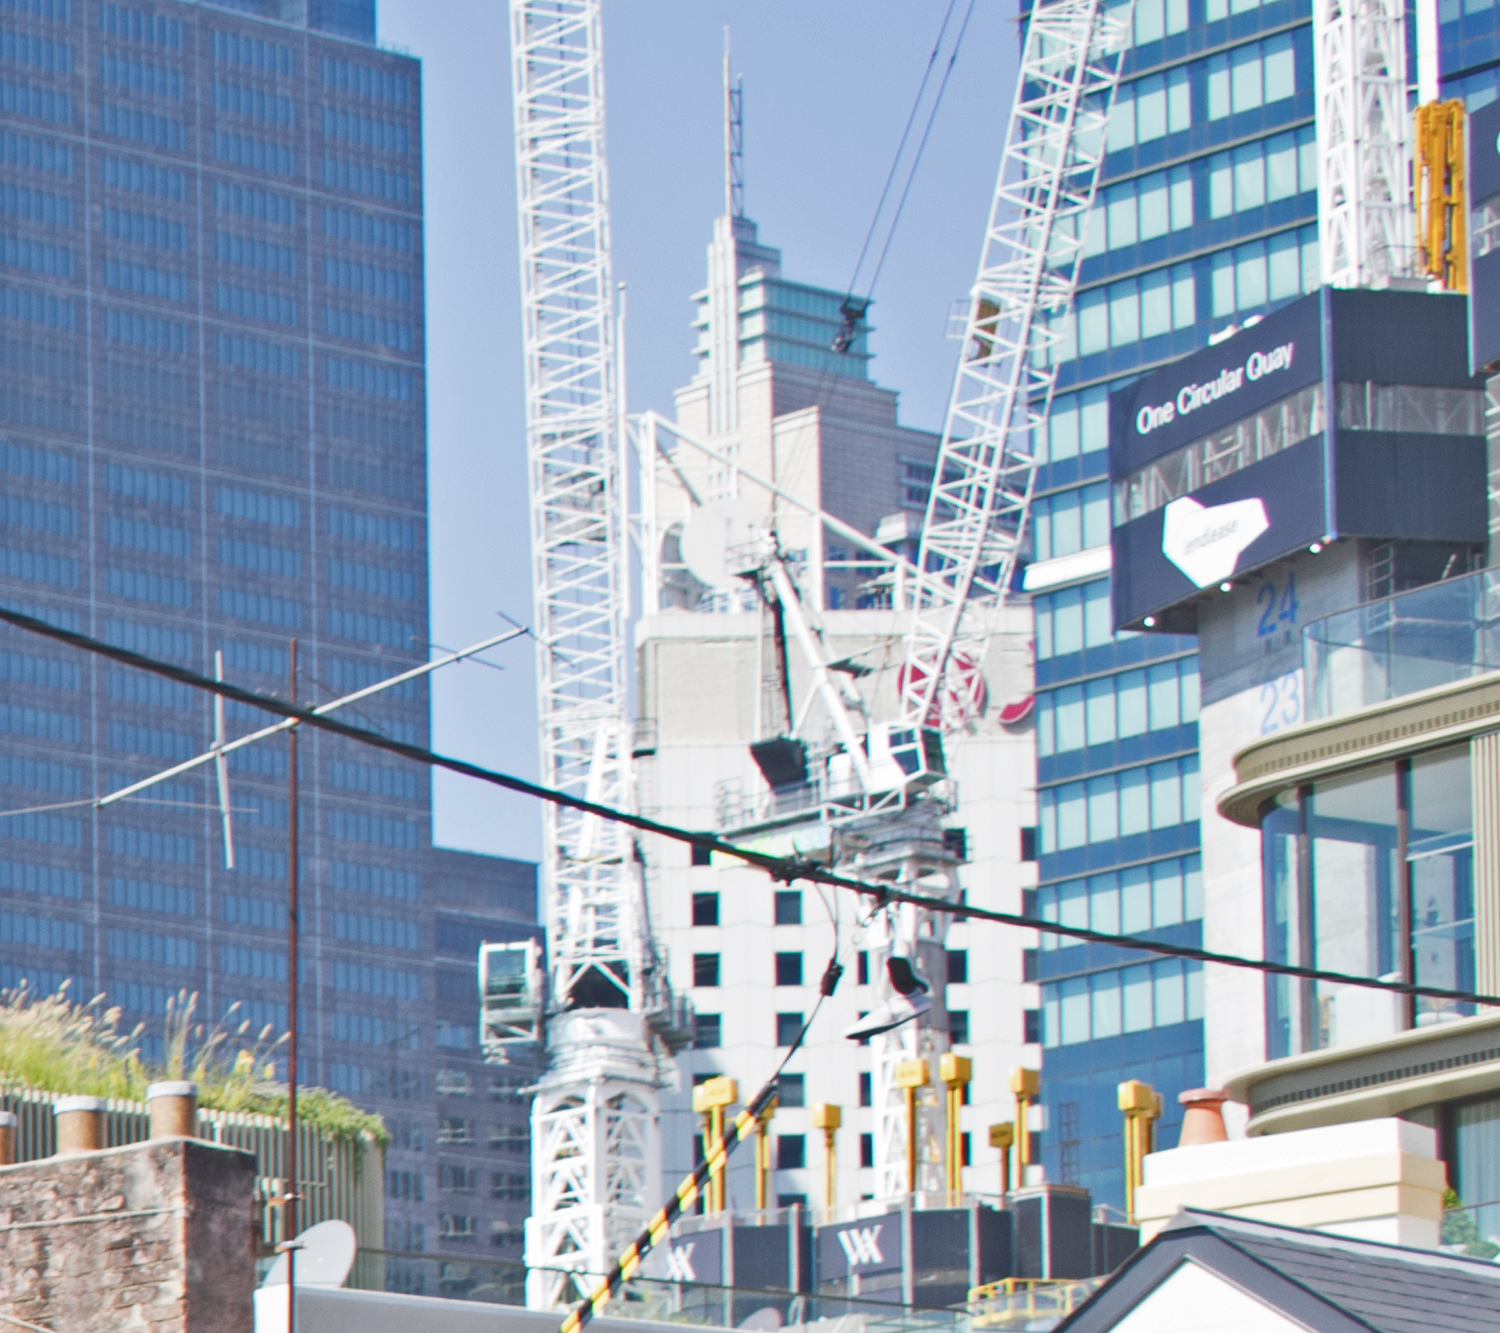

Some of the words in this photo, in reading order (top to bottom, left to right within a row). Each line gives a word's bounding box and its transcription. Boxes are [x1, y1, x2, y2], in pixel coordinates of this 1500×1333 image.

[1136, 401, 1175, 435] One
[1177, 366, 1244, 415] Circular
[1246, 342, 1294, 381] Quay
[1257, 571, 1299, 637] 24
[1260, 670, 1300, 737] 23
